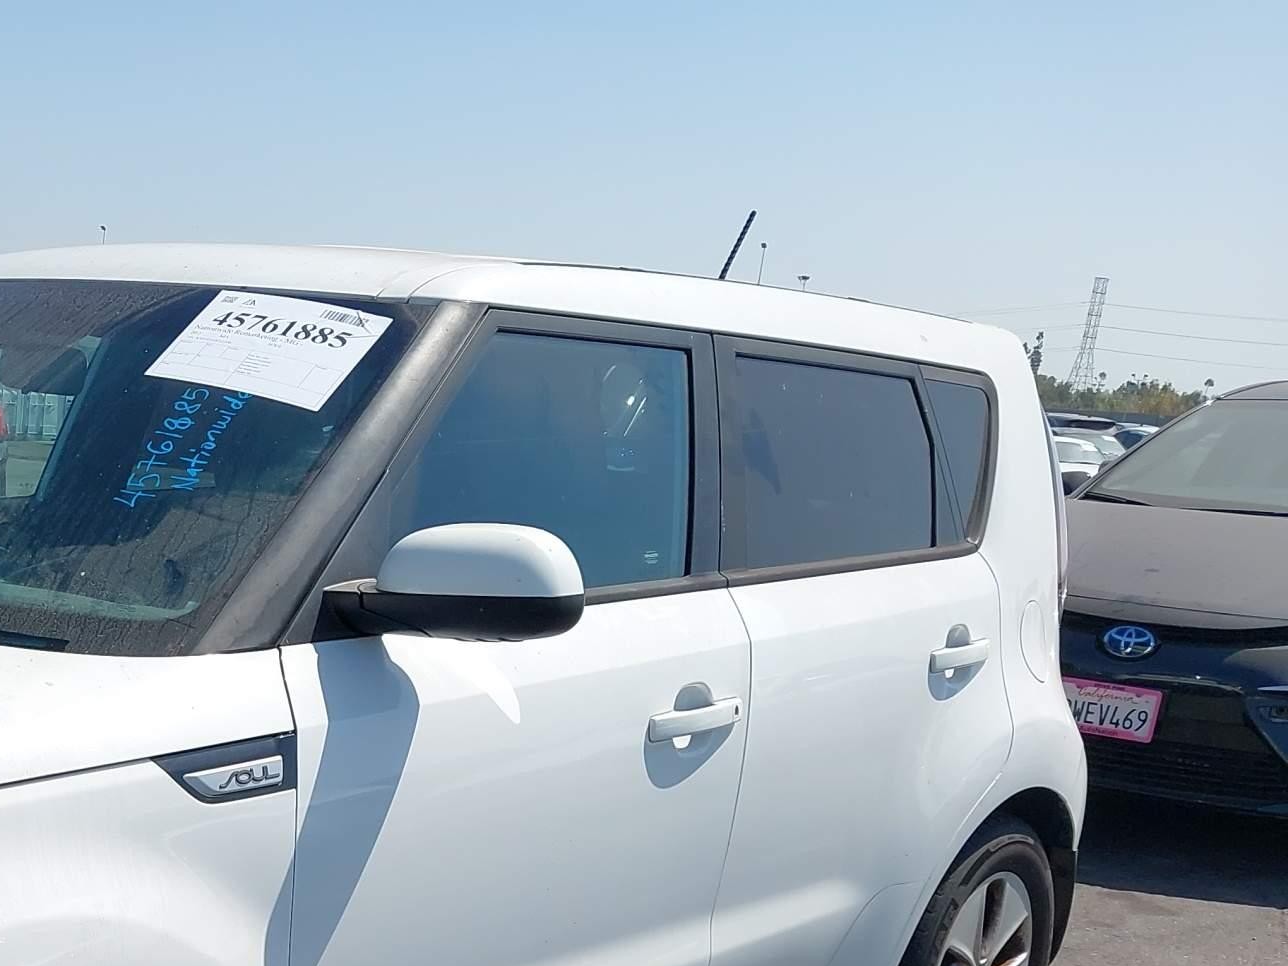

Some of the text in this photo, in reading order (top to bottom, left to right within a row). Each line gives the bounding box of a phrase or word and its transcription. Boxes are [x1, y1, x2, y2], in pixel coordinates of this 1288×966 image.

[212, 311, 353, 349] 45761885
[114, 387, 210, 508] 45761885
[170, 391, 253, 491] Nationwide
[1079, 687, 1139, 704] California
